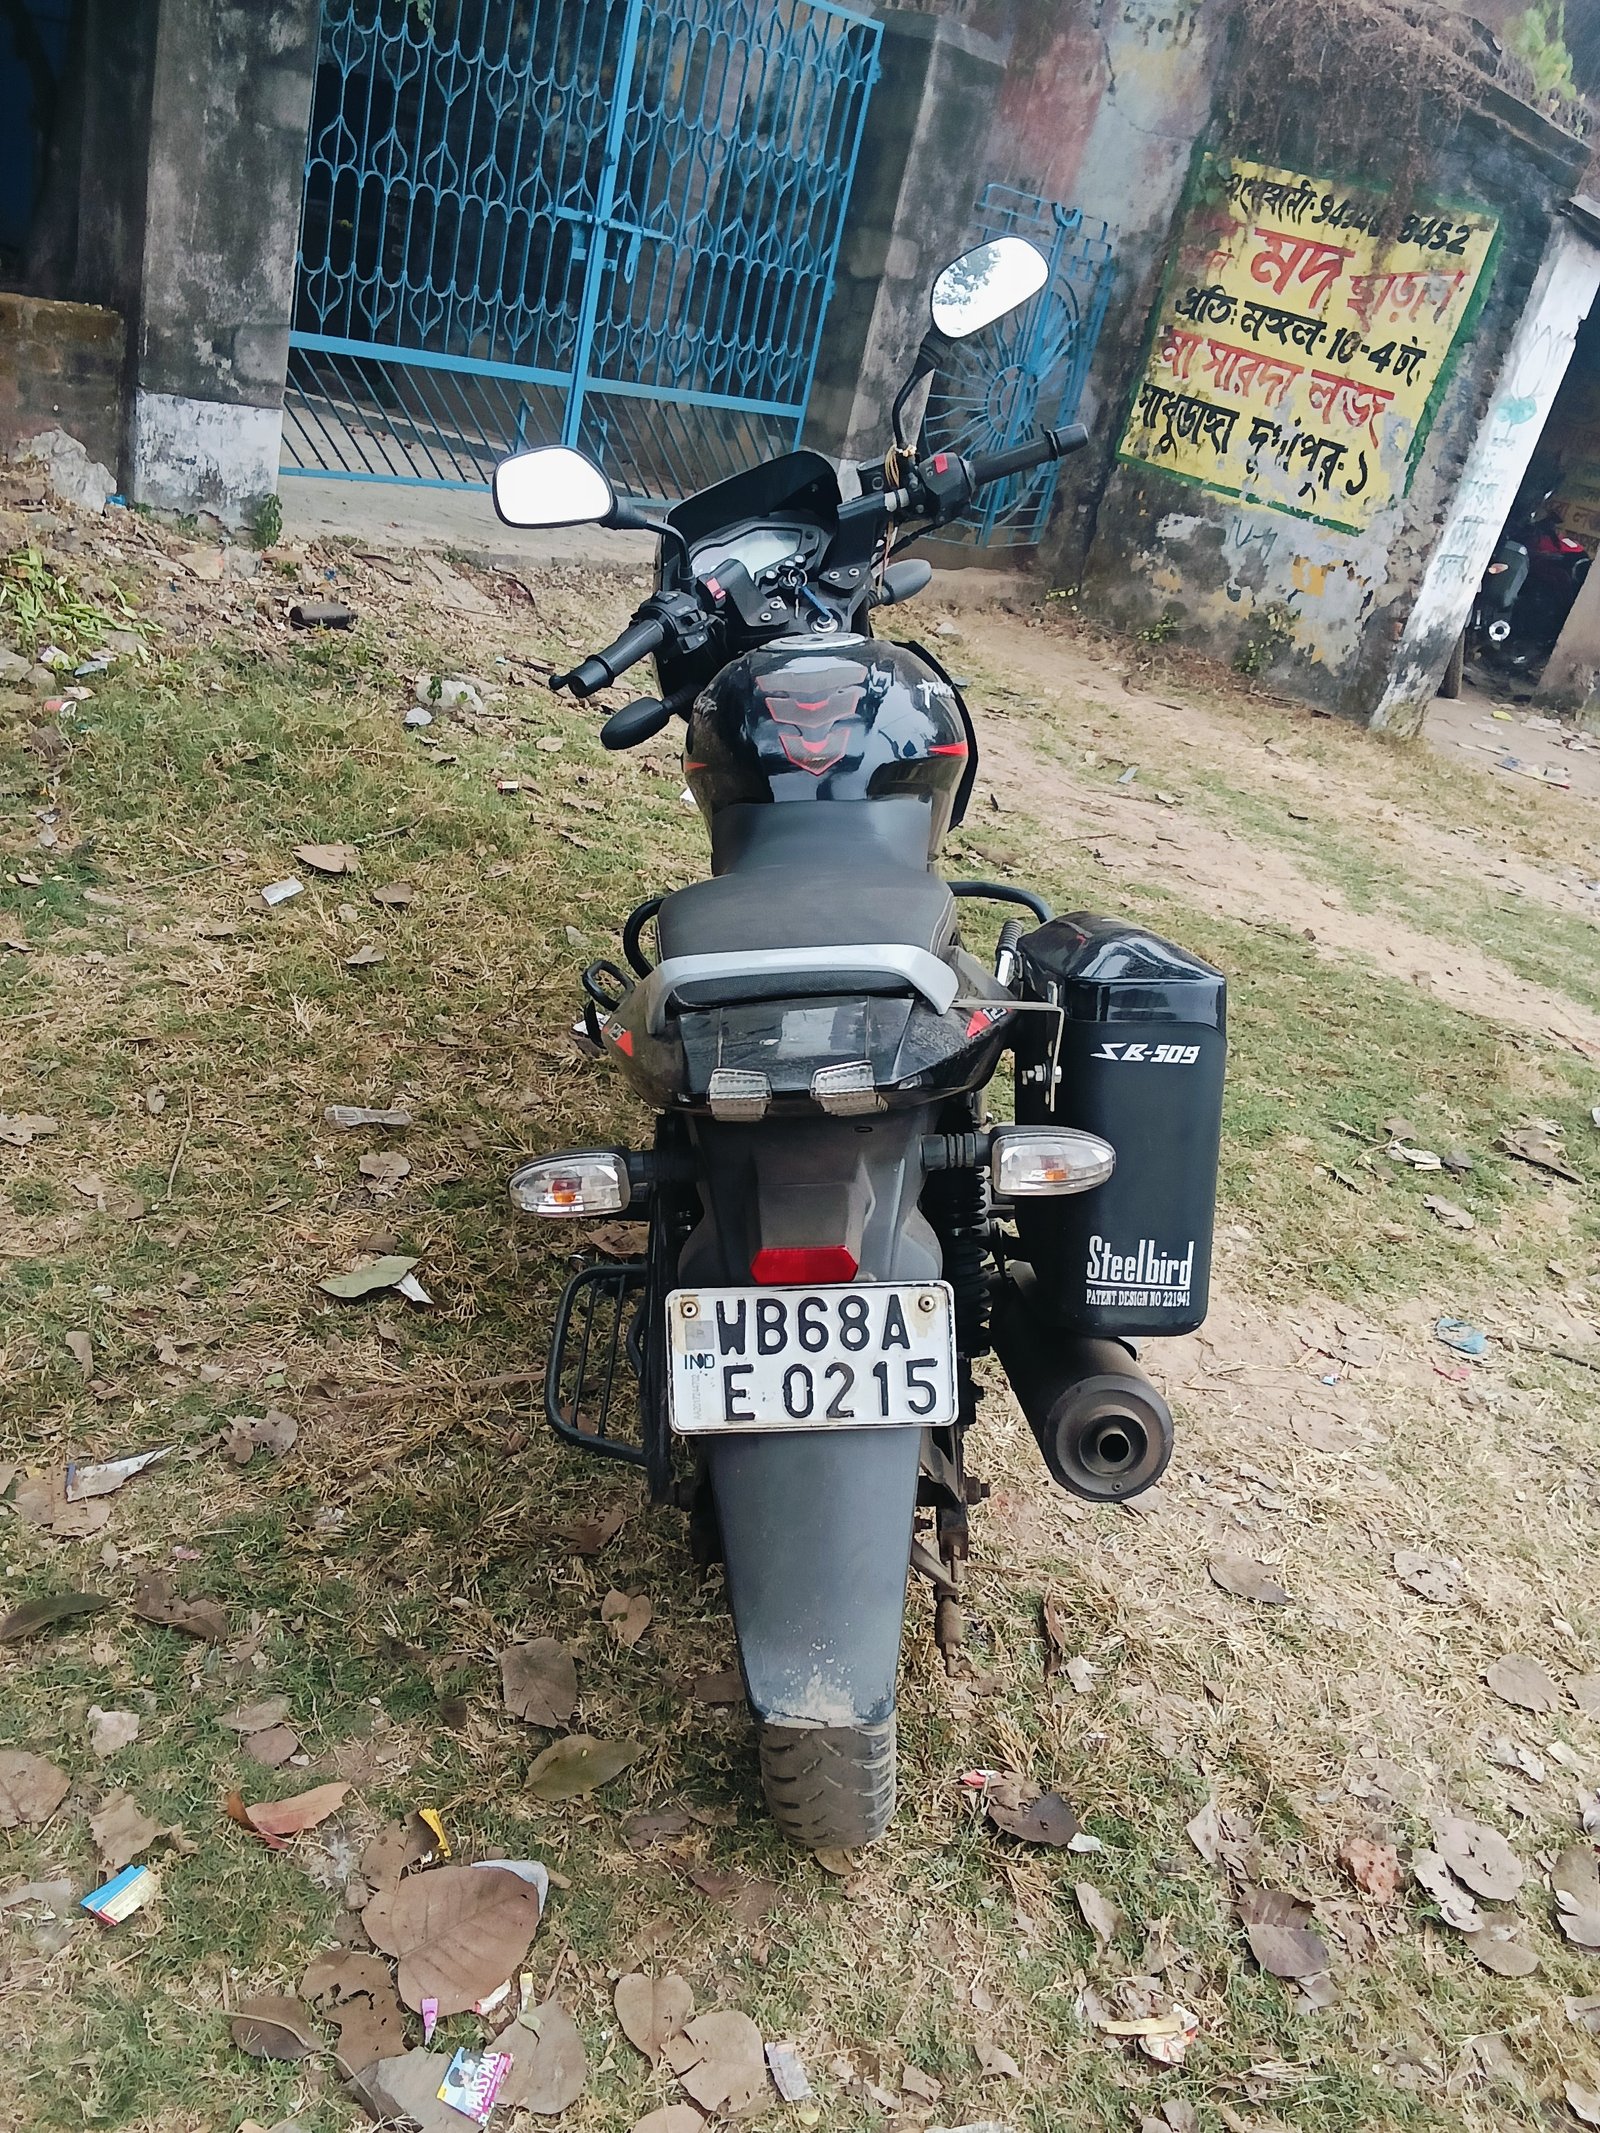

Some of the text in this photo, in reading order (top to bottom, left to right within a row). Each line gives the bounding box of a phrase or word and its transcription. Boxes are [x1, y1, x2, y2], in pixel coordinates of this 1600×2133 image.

[1250, 228, 1355, 309] মদ
[1202, 338, 1306, 407] সারদা
[1090, 1043, 1201, 1064] SB-509
[1086, 1235, 1195, 1290] Steelbird
[715, 1294, 911, 1356] WB68A
[1086, 1289, 1191, 1307] PATENT DESIGN NO 221941
[684, 1352, 715, 1370] IND
